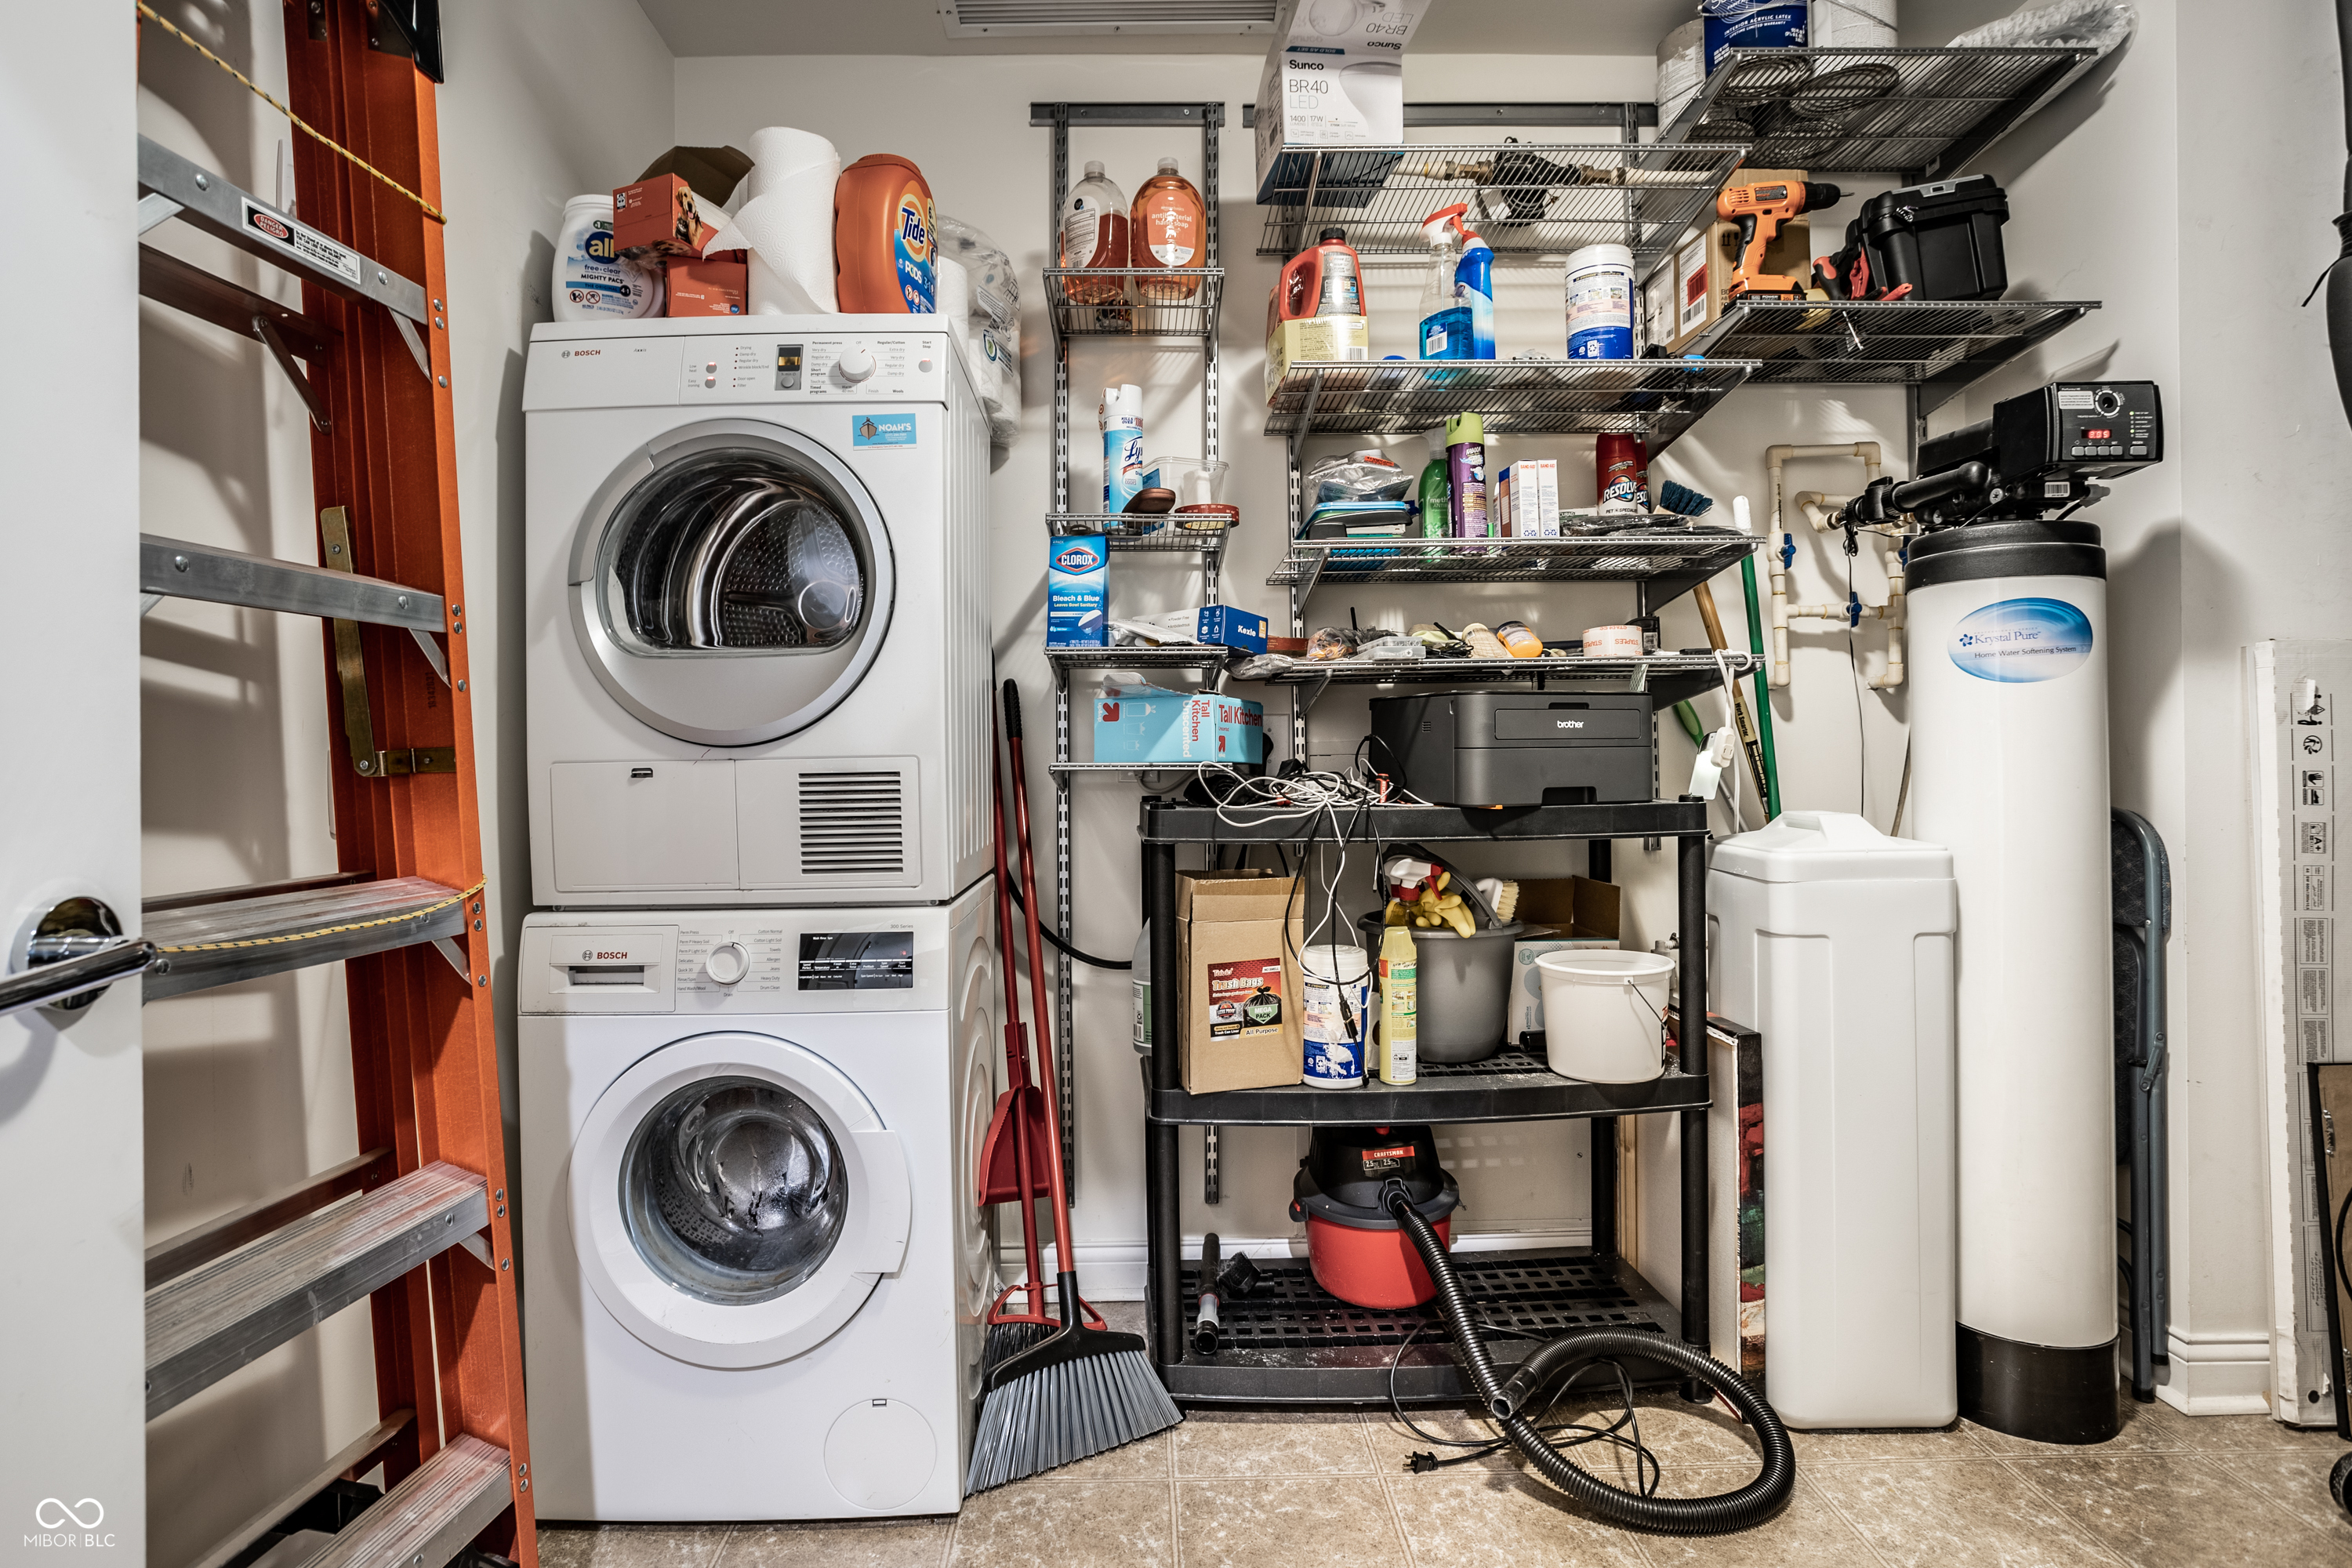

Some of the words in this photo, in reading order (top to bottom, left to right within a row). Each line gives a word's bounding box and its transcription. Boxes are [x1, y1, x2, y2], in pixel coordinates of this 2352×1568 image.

[1381, 13, 1414, 24] LED
[1724, 20, 1748, 35] INTERIOR
[1750, 15, 1774, 24] ACRYLIC
[1367, 23, 1408, 35] BR40
[1367, 41, 1402, 50] Sunco
[1289, 60, 1324, 71] Sunco
[1289, 79, 1328, 94] BR40
[1290, 95, 1319, 109] LED
[260, 216, 283, 230] DANGER
[1152, 212, 1192, 223] antibterial
[1174, 220, 1189, 229] soap
[260, 222, 284, 237] PELIGRO
[902, 207, 925, 245] Tide
[589, 238, 615, 258] all
[603, 267, 621, 275] clear
[905, 260, 922, 284] PODS
[581, 274, 607, 282] MIGHTY
[608, 276, 623, 285] PACS
[595, 284, 618, 292] ORIGINAL
[878, 423, 912, 432] NOAH'S
[1123, 440, 1143, 463] Lys
[1061, 554, 1094, 565] CLOROX
[1237, 625, 1257, 637] Kexle
[1261, 622, 1265, 630] L
[1974, 632, 2011, 646] Krystal
[2013, 630, 2038, 641] Pure
[2021, 647, 2054, 656] Softening
[1201, 700, 1210, 717] Tall
[1218, 704, 1232, 724] Tall
[1234, 706, 1263, 727] Kitchen
[1735, 702, 1744, 716] Work
[1182, 700, 1192, 758] Unscented
[1557, 720, 1584, 728] brother
[1738, 715, 1749, 738] Smarter.
[2314, 837, 2323, 851] A+
[1212, 978, 1240, 991] Trash
[1240, 977, 1264, 988] Bags
[1374, 1149, 1404, 1158] CRAFTSMAN
